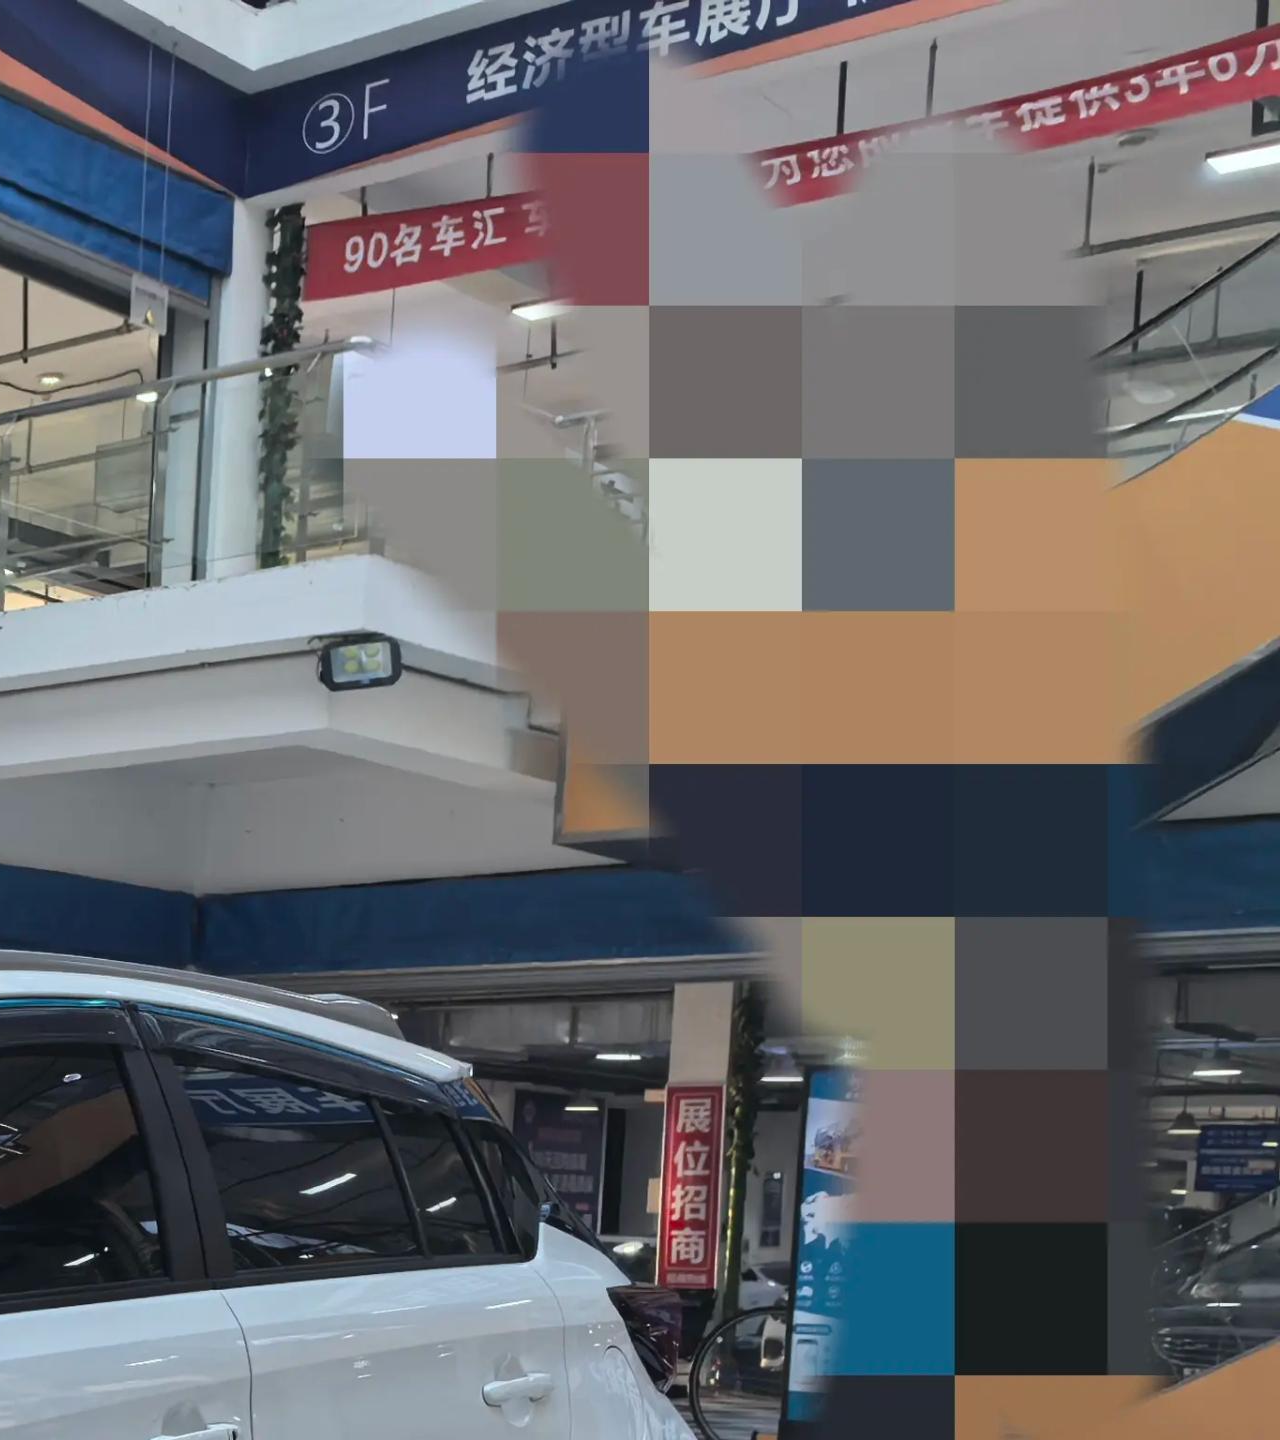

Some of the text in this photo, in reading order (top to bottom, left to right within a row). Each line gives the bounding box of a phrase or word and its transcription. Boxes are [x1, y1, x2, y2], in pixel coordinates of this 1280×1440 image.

[342, 207, 507, 273] 90名车汇
[670, 1097, 712, 1265] 展位招商
